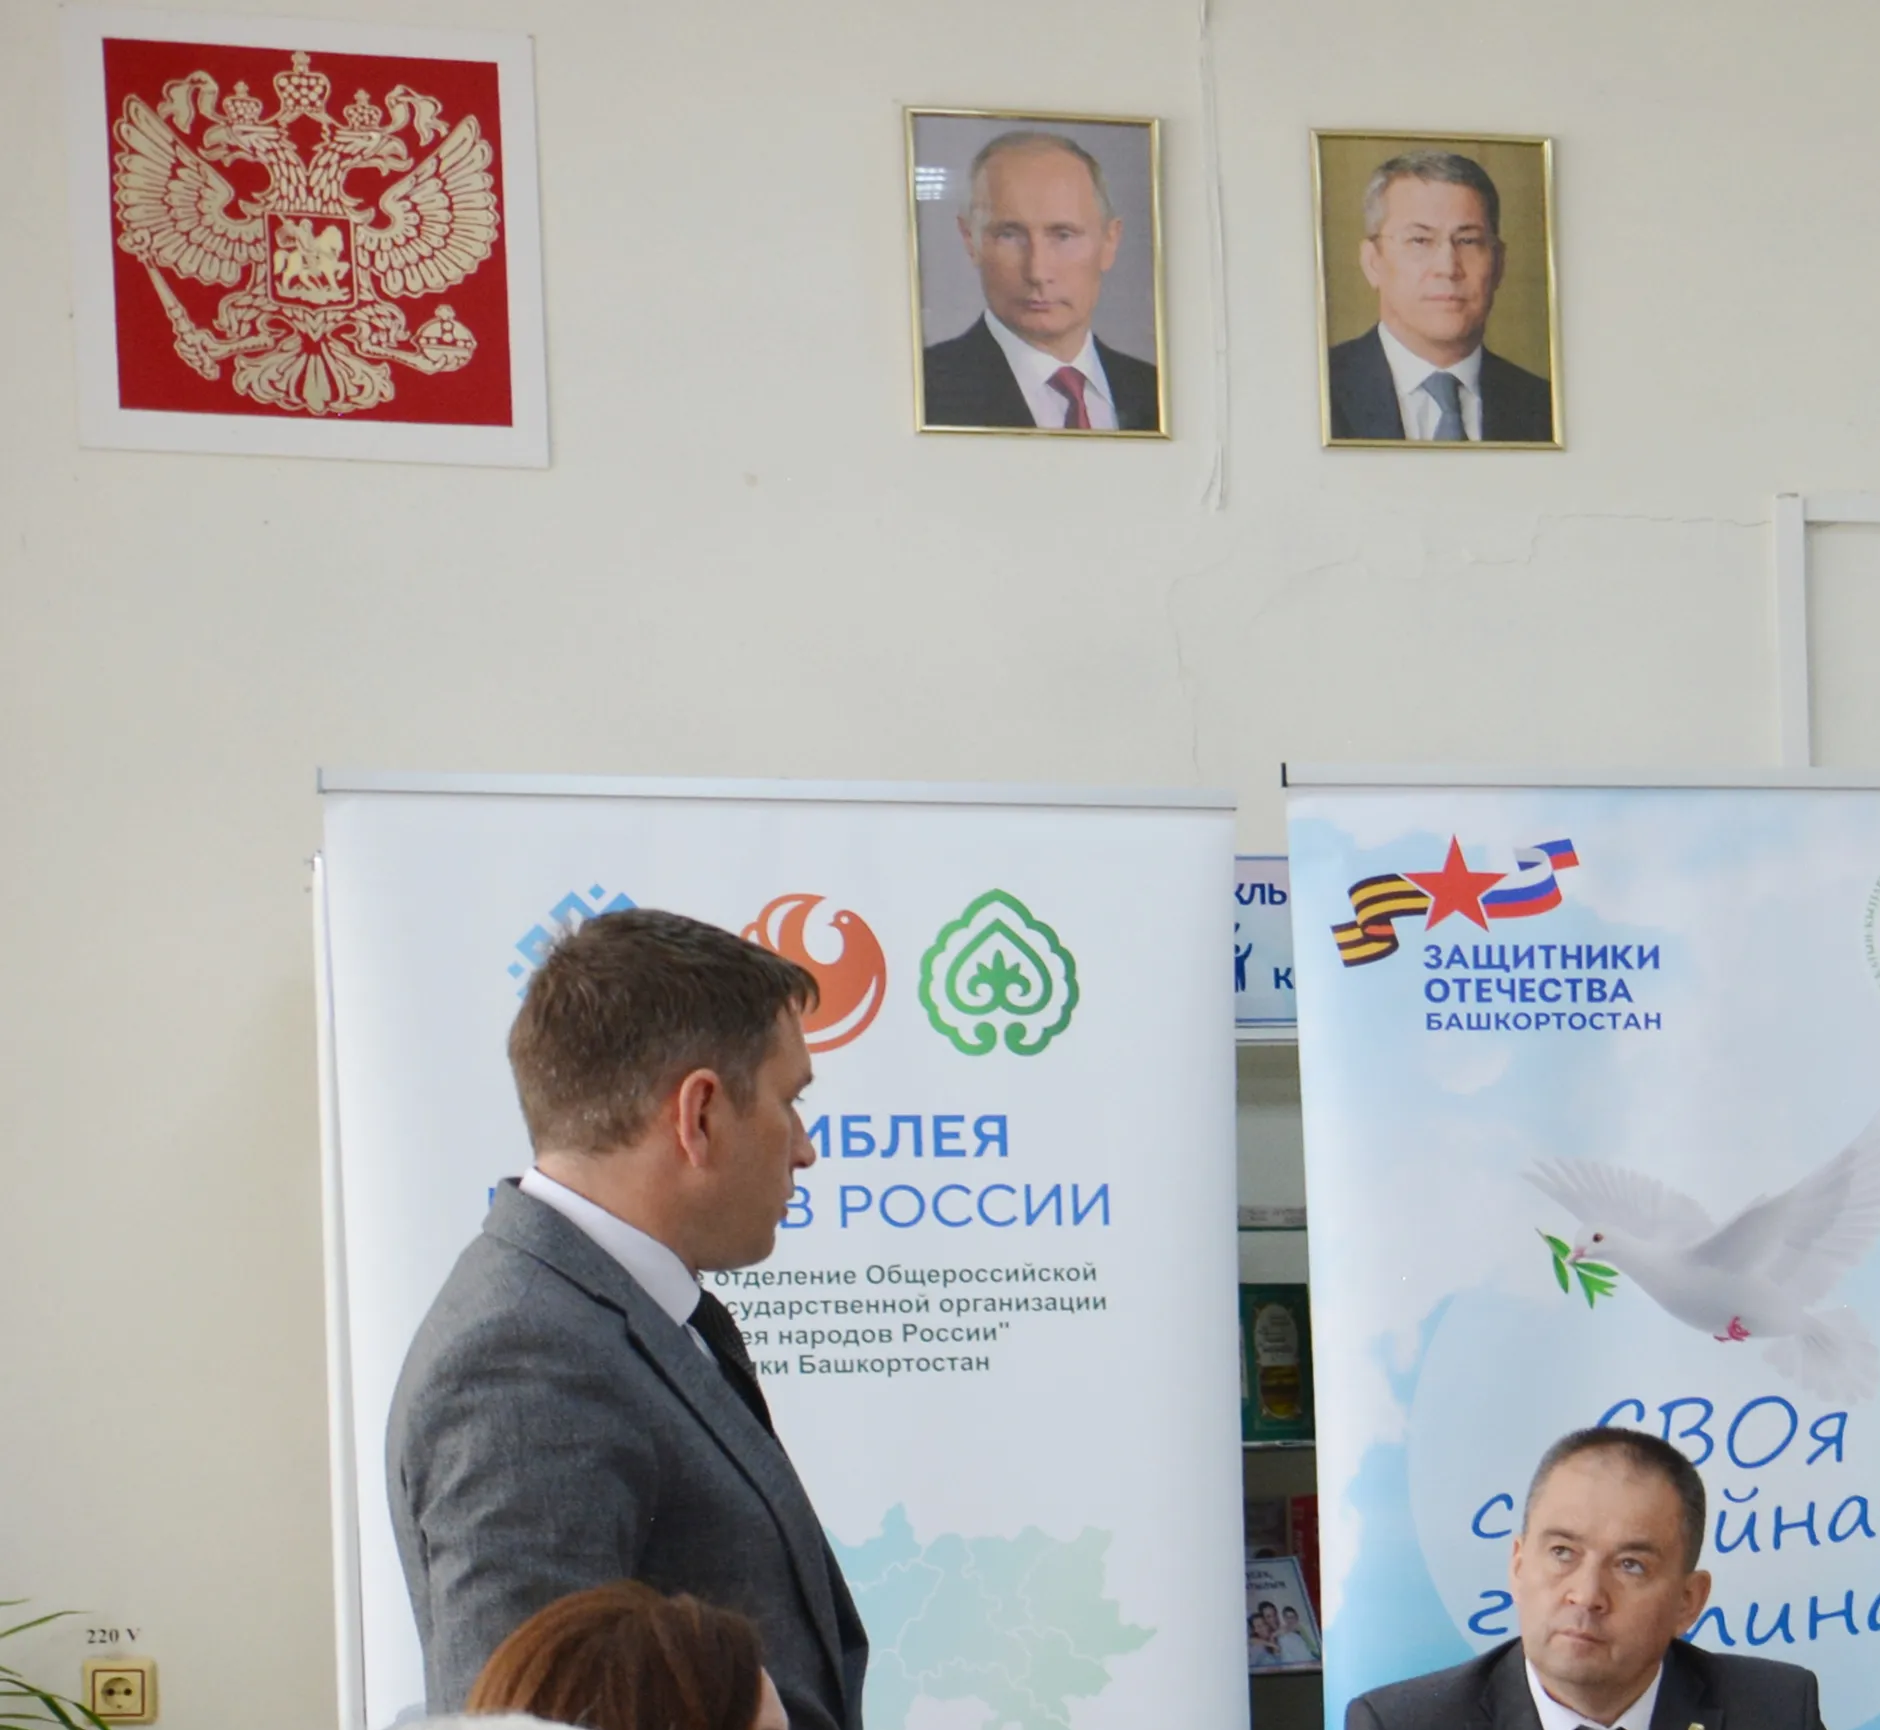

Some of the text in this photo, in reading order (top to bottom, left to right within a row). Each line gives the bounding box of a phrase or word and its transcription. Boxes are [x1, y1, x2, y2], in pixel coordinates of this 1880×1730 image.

[1423, 943, 1660, 974] ЗАЩИТНИКИ
[1424, 976, 1634, 1005] ОТЕЧЕСТВА
[1425, 1011, 1662, 1032] БАШКОРТОСТАН
[801, 1114, 1009, 1159] МБЛЕЯ
[839, 1183, 1111, 1229] РОССИИ
[714, 1266, 856, 1289] отделение
[866, 1262, 1097, 1289] Общероссийской
[726, 1292, 1107, 1320] сударственной организации
[778, 1325, 893, 1350] народов
[902, 1320, 1010, 1343] России"
[799, 1354, 990, 1378] Башкортостан
[86, 1628, 120, 1644] 220
